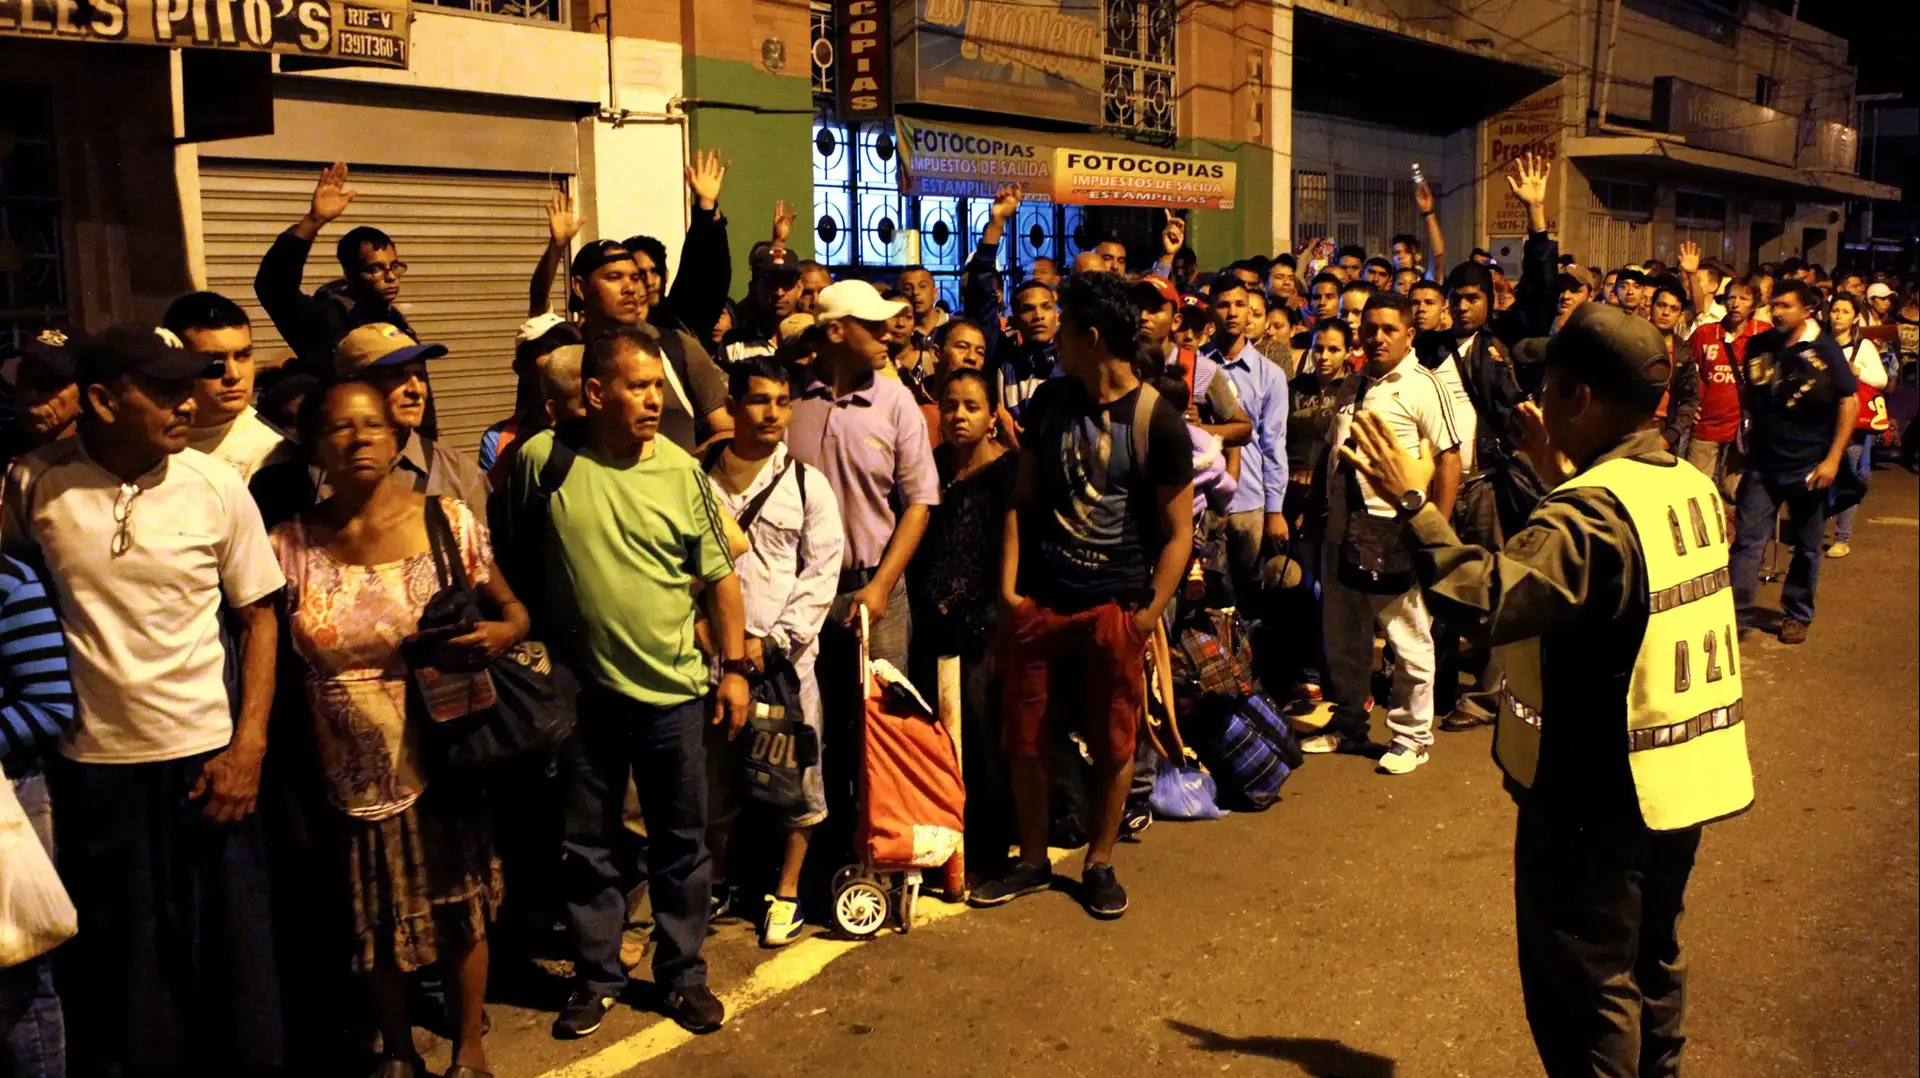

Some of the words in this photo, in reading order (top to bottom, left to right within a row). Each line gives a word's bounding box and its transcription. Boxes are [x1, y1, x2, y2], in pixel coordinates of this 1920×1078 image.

[156, 0, 331, 50] PITO'S
[347, 7, 391, 29] RIF-V
[849, 0, 878, 110] COPIAS
[913, 128, 1035, 158] FOTOCOPIAS
[1492, 139, 1557, 162] Precios
[911, 156, 977, 174] IMPUESTOS
[981, 160, 997, 175] DE
[1000, 160, 1049, 177] SALIDA
[1068, 153, 1224, 178] FOTOCOPIAS
[1073, 174, 1152, 188] IMPUESTOS
[1155, 180, 1173, 189] DE
[1176, 180, 1222, 193] SALIDA
